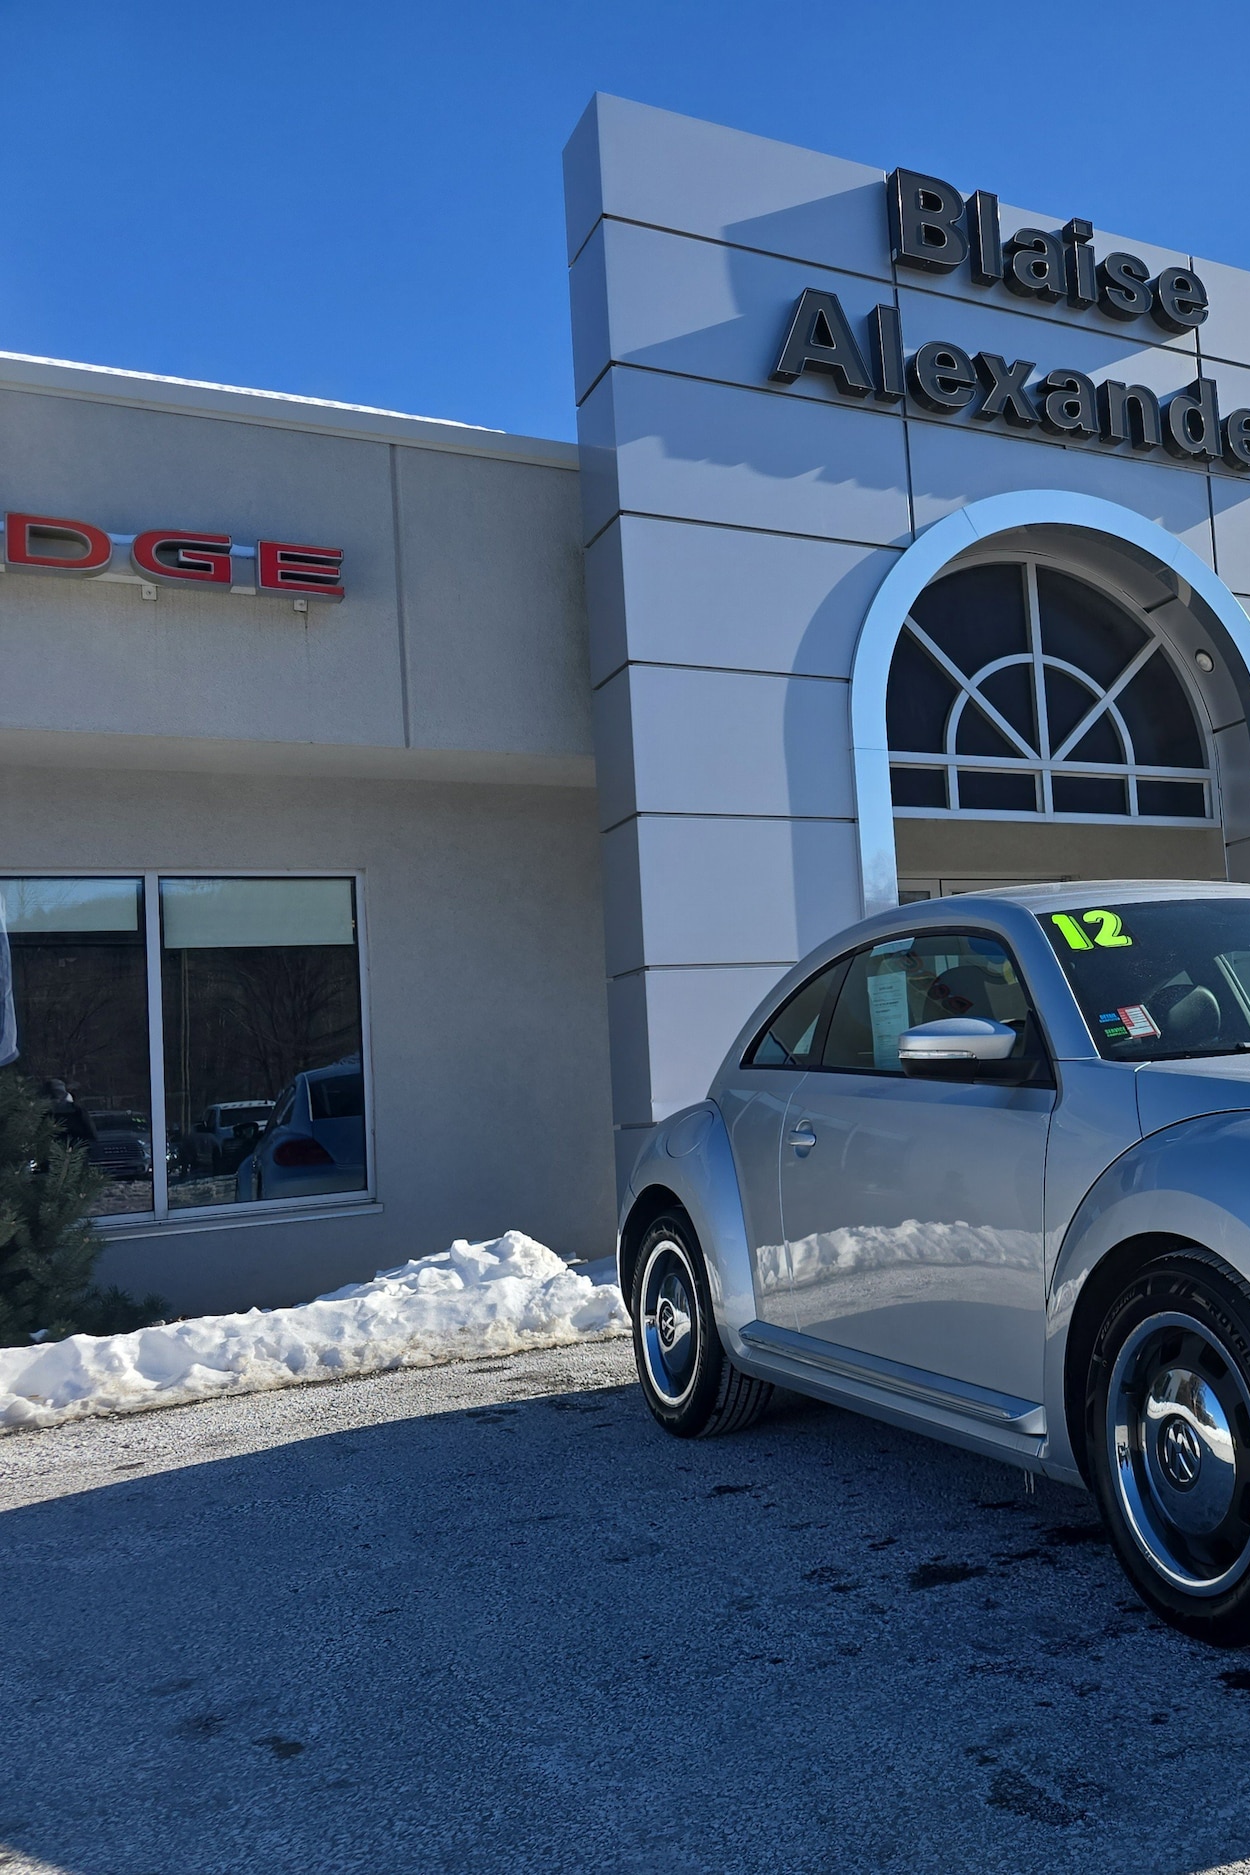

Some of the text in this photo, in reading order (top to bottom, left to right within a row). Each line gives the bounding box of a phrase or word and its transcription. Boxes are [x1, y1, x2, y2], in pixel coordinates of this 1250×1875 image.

[888, 167, 1209, 335] Blaise
[2, 511, 345, 602] DGE
[1052, 910, 1133, 951] 12
